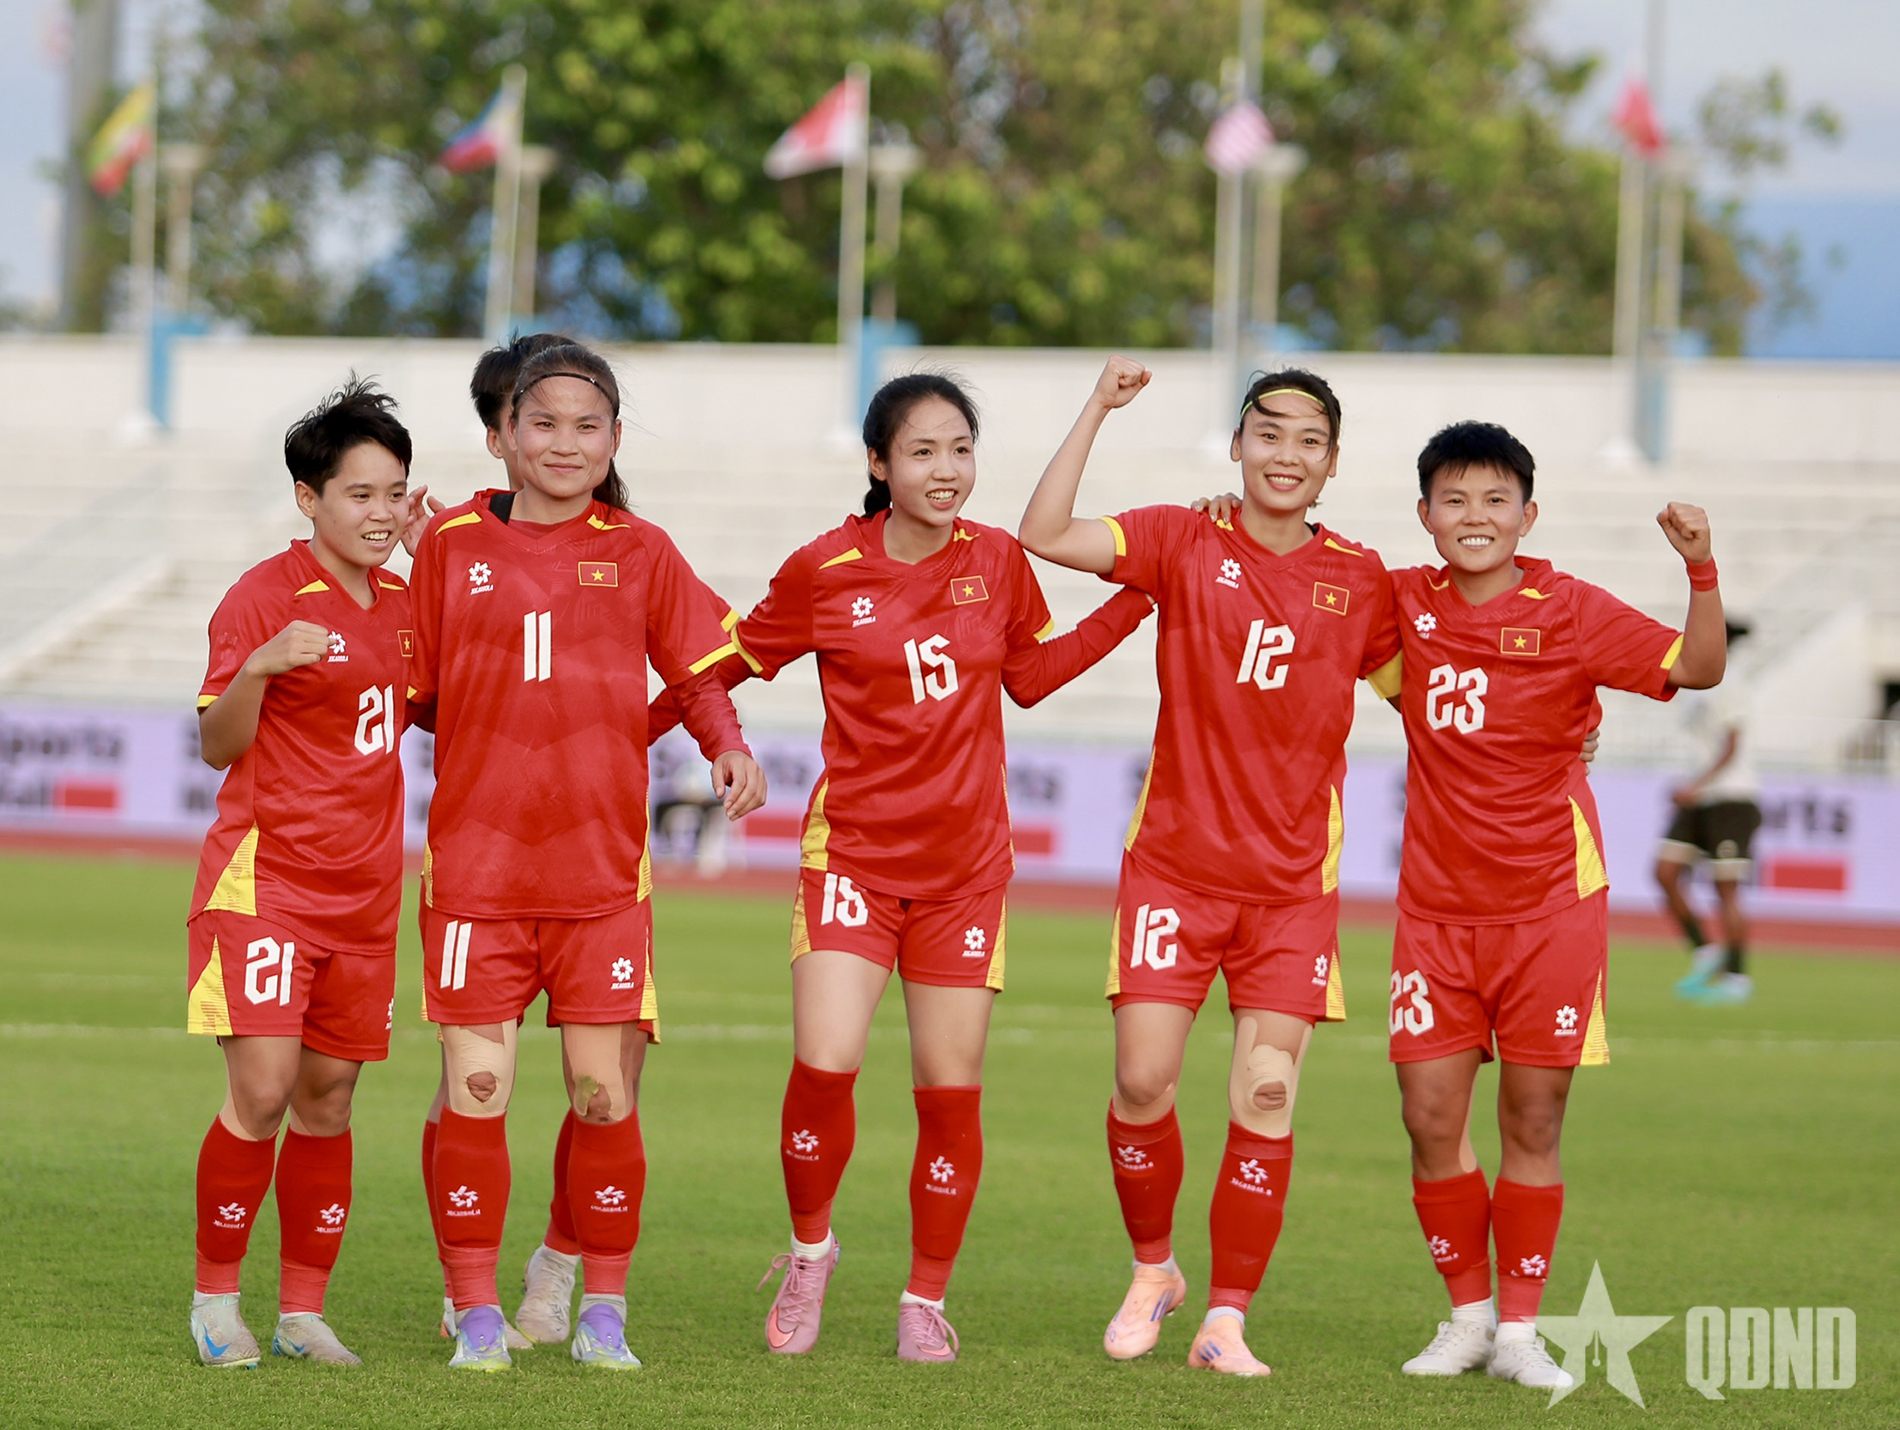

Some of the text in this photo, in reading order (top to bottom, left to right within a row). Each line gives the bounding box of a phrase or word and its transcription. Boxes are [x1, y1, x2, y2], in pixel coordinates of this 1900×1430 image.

[523, 611, 552, 682] 11
[903, 633, 959, 705] 15
[1237, 619, 1296, 690] 12
[354, 684, 395, 756] 21
[1426, 663, 1489, 735] 23
[820, 872, 869, 928] 15
[244, 937, 295, 1006] 21
[440, 920, 472, 991] 11
[1130, 903, 1181, 971] 12
[1389, 969, 1435, 1036] 23
